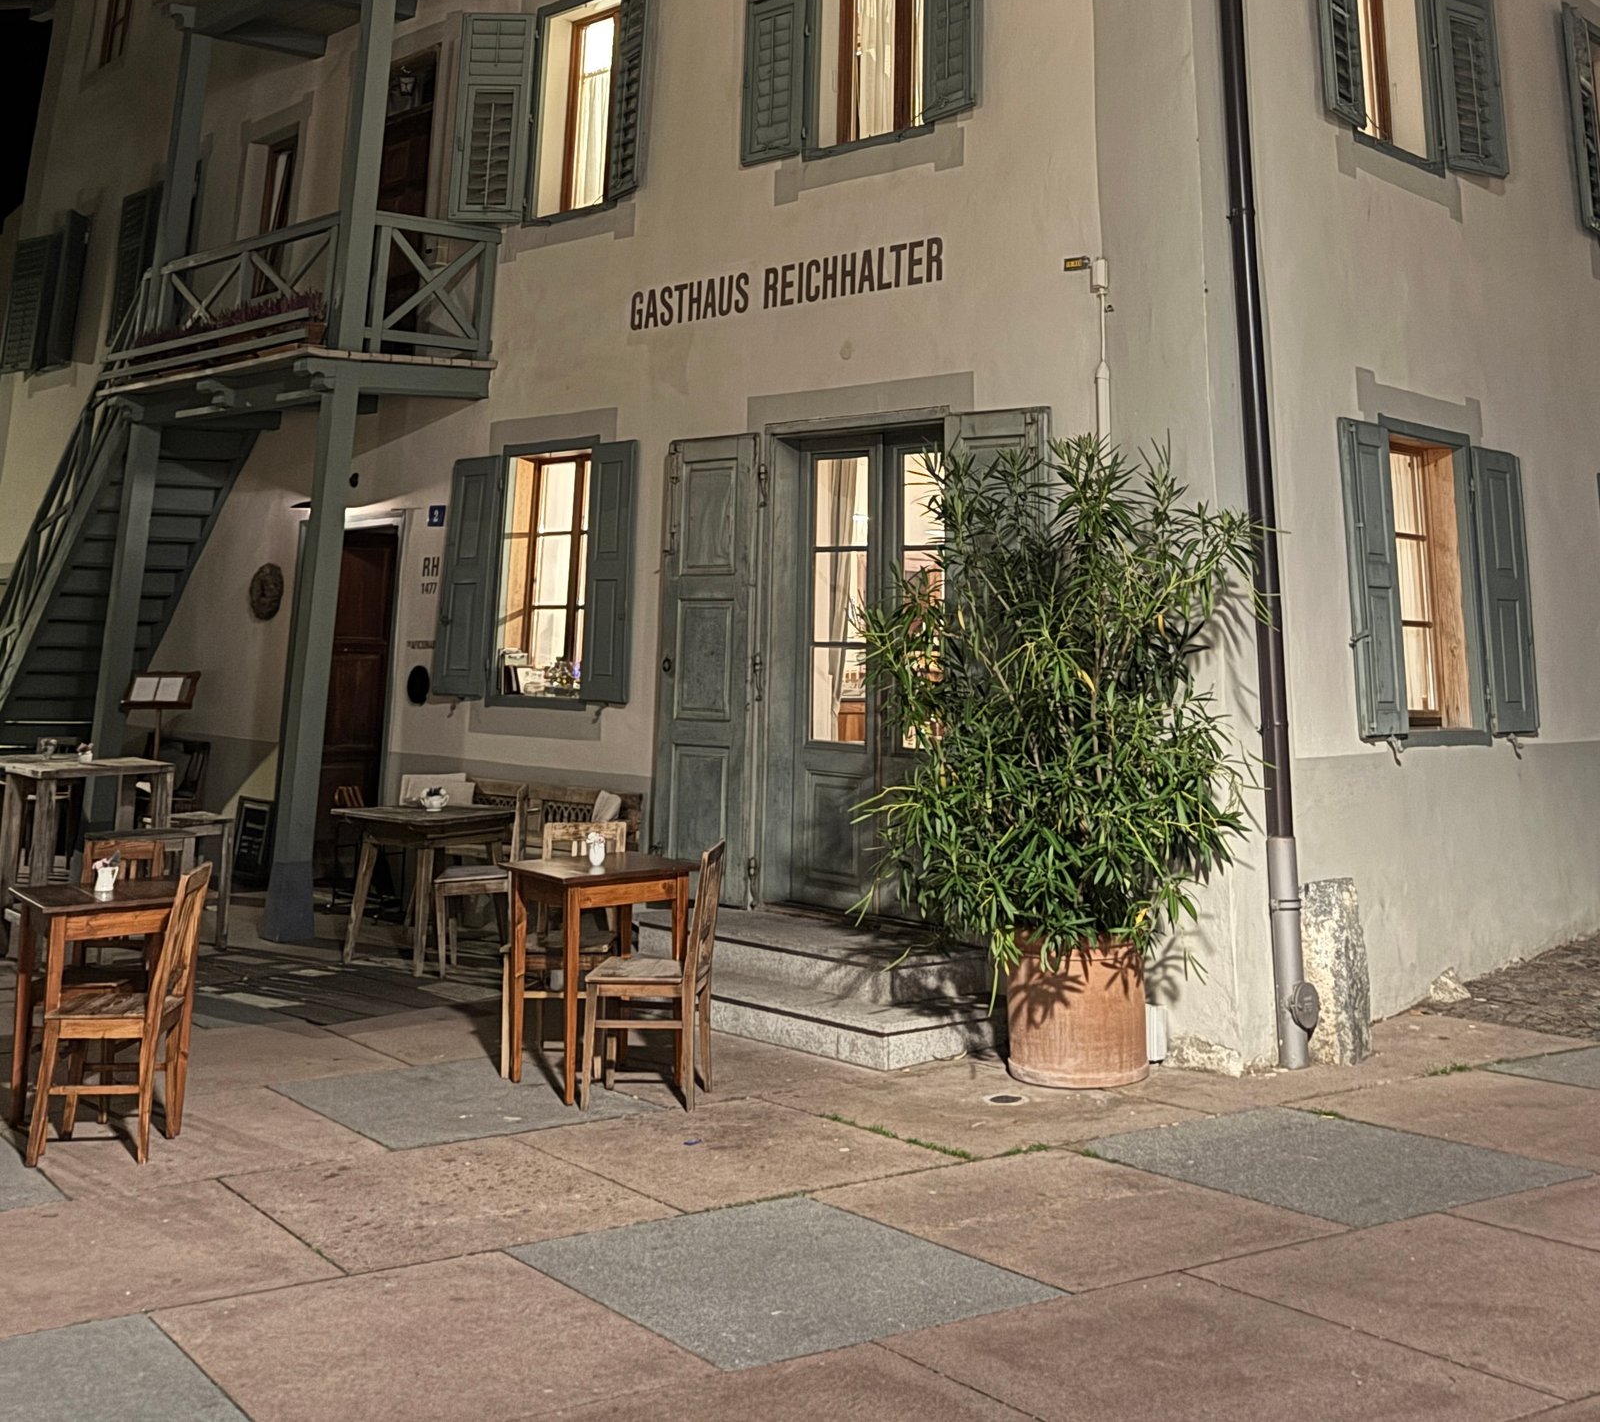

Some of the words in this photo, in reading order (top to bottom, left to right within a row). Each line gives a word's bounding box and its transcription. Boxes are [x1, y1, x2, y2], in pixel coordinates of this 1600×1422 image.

[630, 272, 750, 331] GASTHAUS
[763, 236, 944, 310] REICHHALTER
[432, 509, 439, 523] 2
[422, 556, 440, 577] RH
[421, 581, 438, 595] 1477
